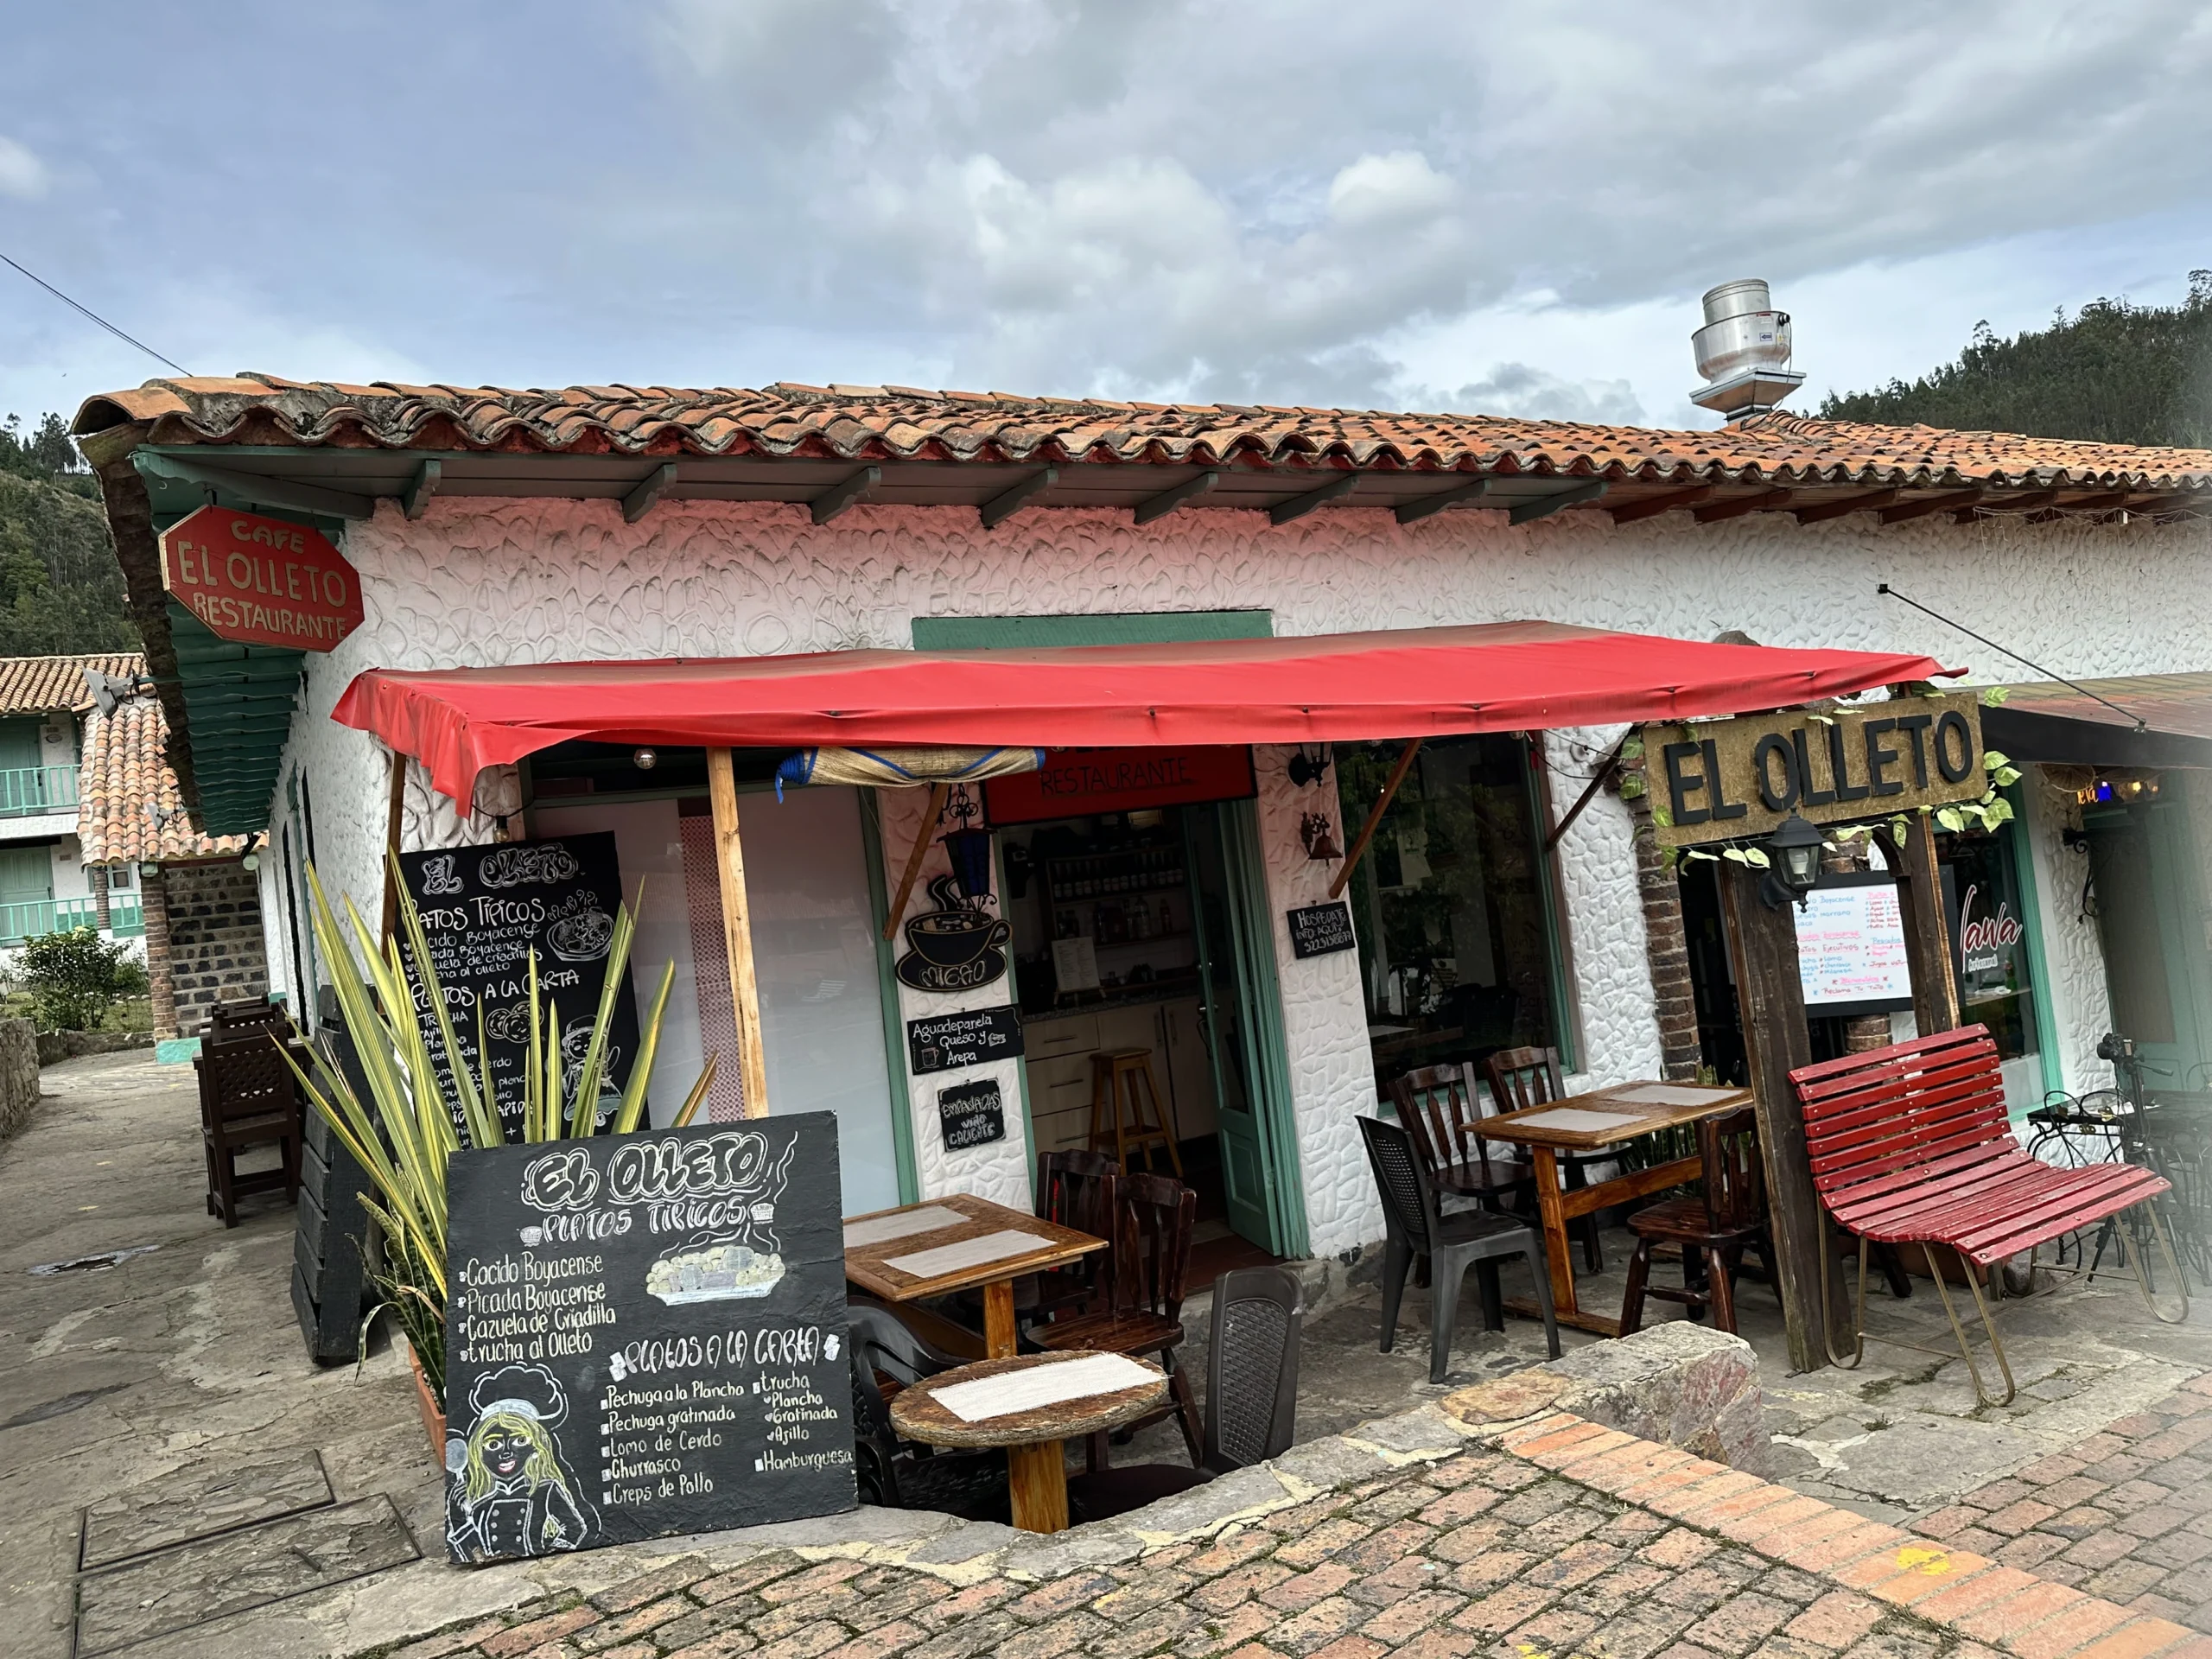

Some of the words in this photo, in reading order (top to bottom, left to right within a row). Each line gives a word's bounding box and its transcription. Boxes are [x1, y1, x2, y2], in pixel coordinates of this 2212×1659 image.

[231, 520, 305, 554] CAFE
[177, 540, 219, 587] EL
[226, 551, 346, 607] OLLETO
[193, 592, 347, 640] RESTAURANTE
[1040, 757, 1192, 796] RESTAURANTE
[1663, 738, 1747, 826] EL
[1755, 710, 1974, 811] OLLETO
[421, 855, 464, 895] EL
[466, 923, 541, 945] Boyacense
[459, 939, 524, 959] Boyacense
[467, 957, 483, 966] de
[460, 967, 471, 977] al
[475, 963, 510, 975] olleto
[485, 983, 497, 999] A
[500, 980, 519, 997] LA
[939, 1033, 976, 1050] Queso
[978, 1031, 986, 1045] y
[946, 1050, 977, 1065] Arepa
[530, 1147, 601, 1211] EL
[609, 1132, 768, 1201] OLLETO
[543, 1207, 632, 1243] PLATOS
[467, 1254, 518, 1287] Cocido
[522, 1251, 603, 1287] Boyacense
[466, 1287, 521, 1314] Picada
[524, 1282, 606, 1314] Boyacense
[467, 1312, 528, 1341] Cazuela
[530, 1310, 548, 1333] de
[555, 1302, 616, 1331] Criadilla
[467, 1338, 524, 1363] trucha
[530, 1335, 543, 1360] al
[548, 1328, 593, 1357] Olleto
[706, 1334, 721, 1369] A
[727, 1330, 747, 1368] LA
[606, 1385, 663, 1408] Pechuga
[664, 1389, 673, 1402] a
[676, 1383, 688, 1400] la
[691, 1380, 744, 1398] Plancha
[760, 1370, 810, 1392] trucha
[772, 1389, 823, 1408] Plancha
[608, 1411, 664, 1433] Pechuga
[666, 1404, 735, 1433] gratinada
[772, 1406, 838, 1424] Gratinada
[610, 1437, 647, 1457] Lomo
[655, 1434, 672, 1452] de
[679, 1427, 721, 1451] Cerdo
[775, 1424, 810, 1446] Ajillo
[612, 1458, 682, 1479] Churrasco
[764, 1449, 854, 1472] Hamburguesa
[613, 1483, 652, 1506] Creps
[658, 1478, 674, 1497] de
[679, 1471, 714, 1496] Pollo
